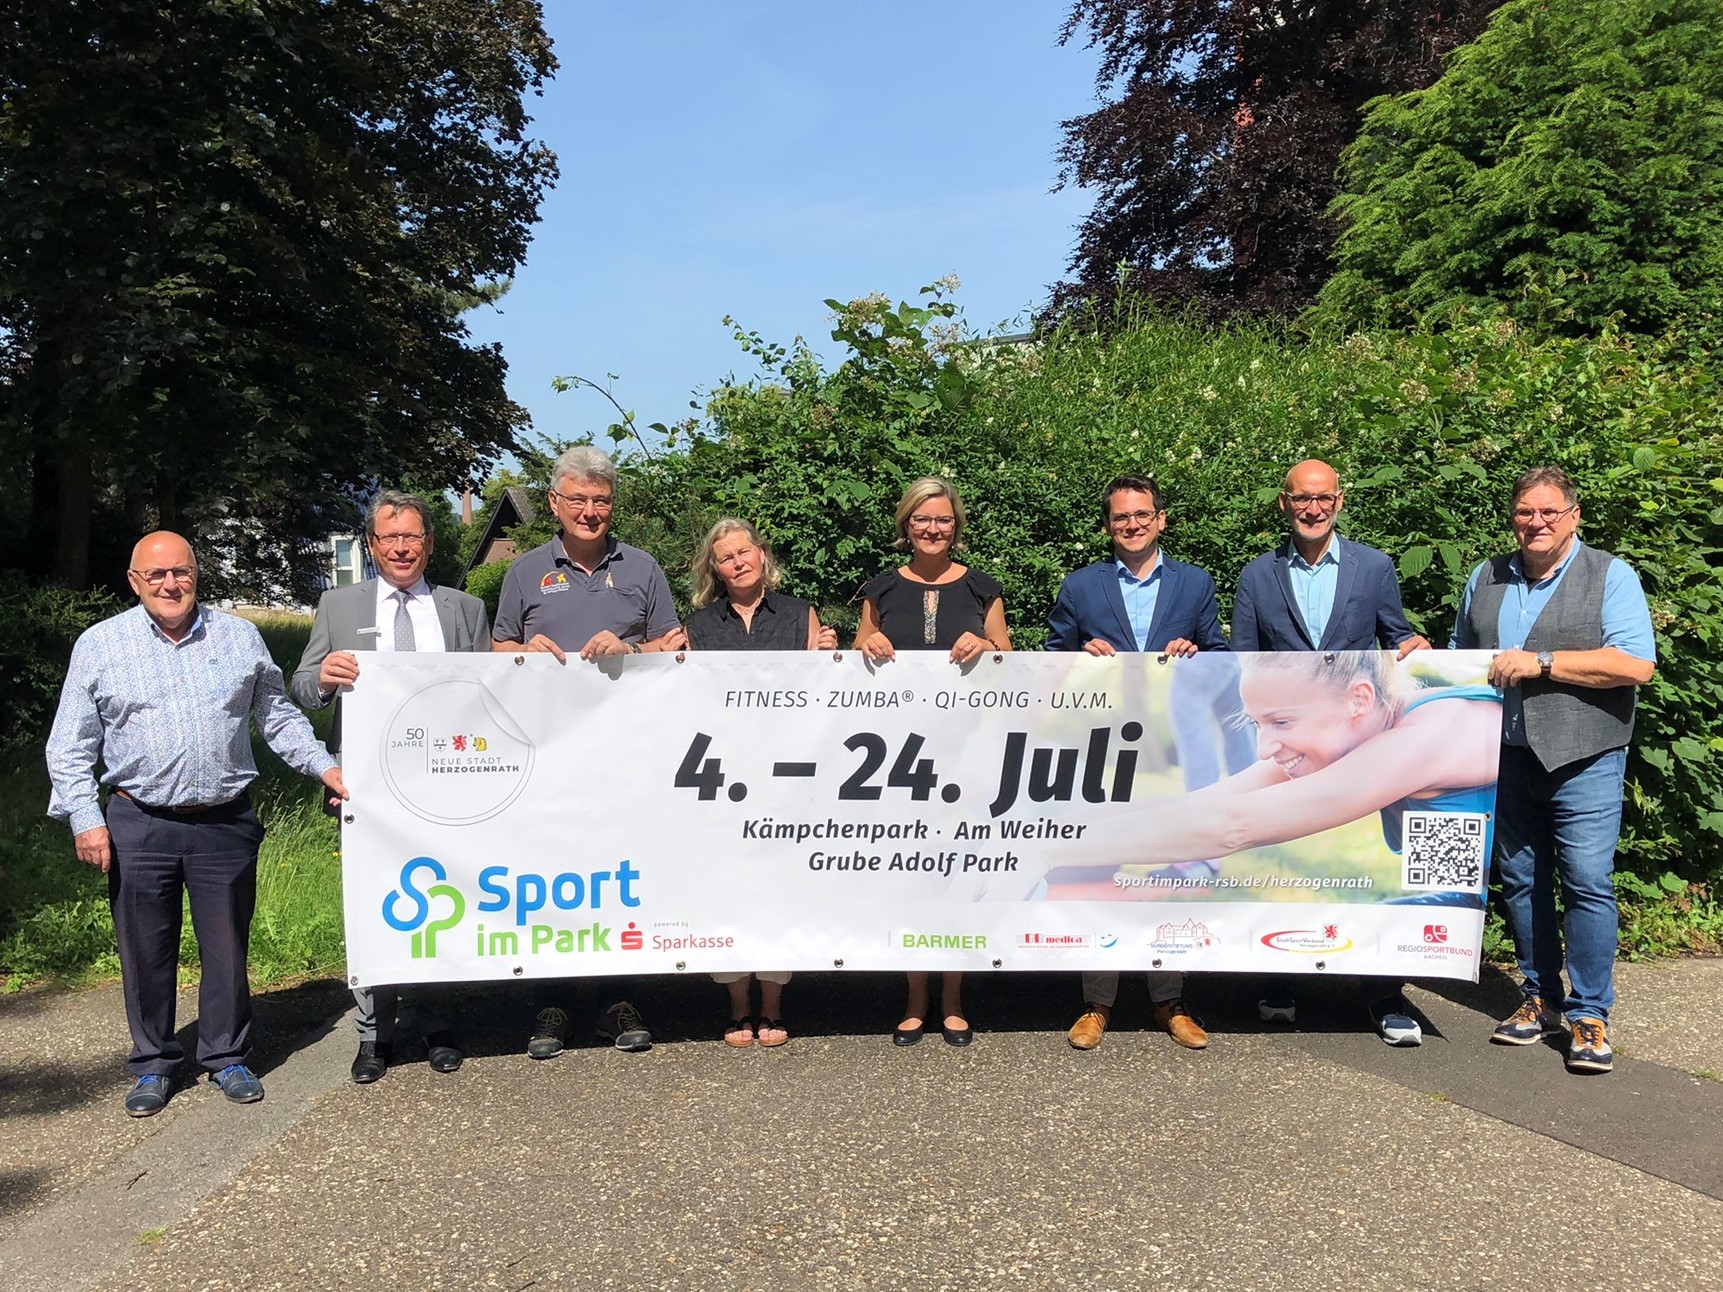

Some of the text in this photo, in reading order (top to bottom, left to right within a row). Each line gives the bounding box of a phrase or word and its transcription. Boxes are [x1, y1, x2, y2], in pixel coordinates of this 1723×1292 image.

[724, 690, 808, 708] FITNESS
[935, 690, 1029, 710] QI-GONG
[1050, 691, 1113, 709] U.V.M.
[406, 728, 424, 740] 50
[391, 740, 424, 748] JAHRE
[432, 765, 519, 774] HERZOGENRATH
[467, 757, 502, 765] STADT
[674, 731, 748, 803] 4.
[838, 731, 962, 803] 24.
[989, 721, 1143, 819] Juli
[742, 817, 1086, 844] Kämpchenpark Am Weiher
[808, 850, 1018, 876] Grube Adolf Park
[477, 859, 641, 926] Sport
[477, 921, 612, 957] im Park
[652, 933, 734, 953] Sparkasse
[903, 934, 987, 949] BARMER
[1046, 935, 1082, 943] medica
[1397, 945, 1473, 957] REGIOSPORTBUND
